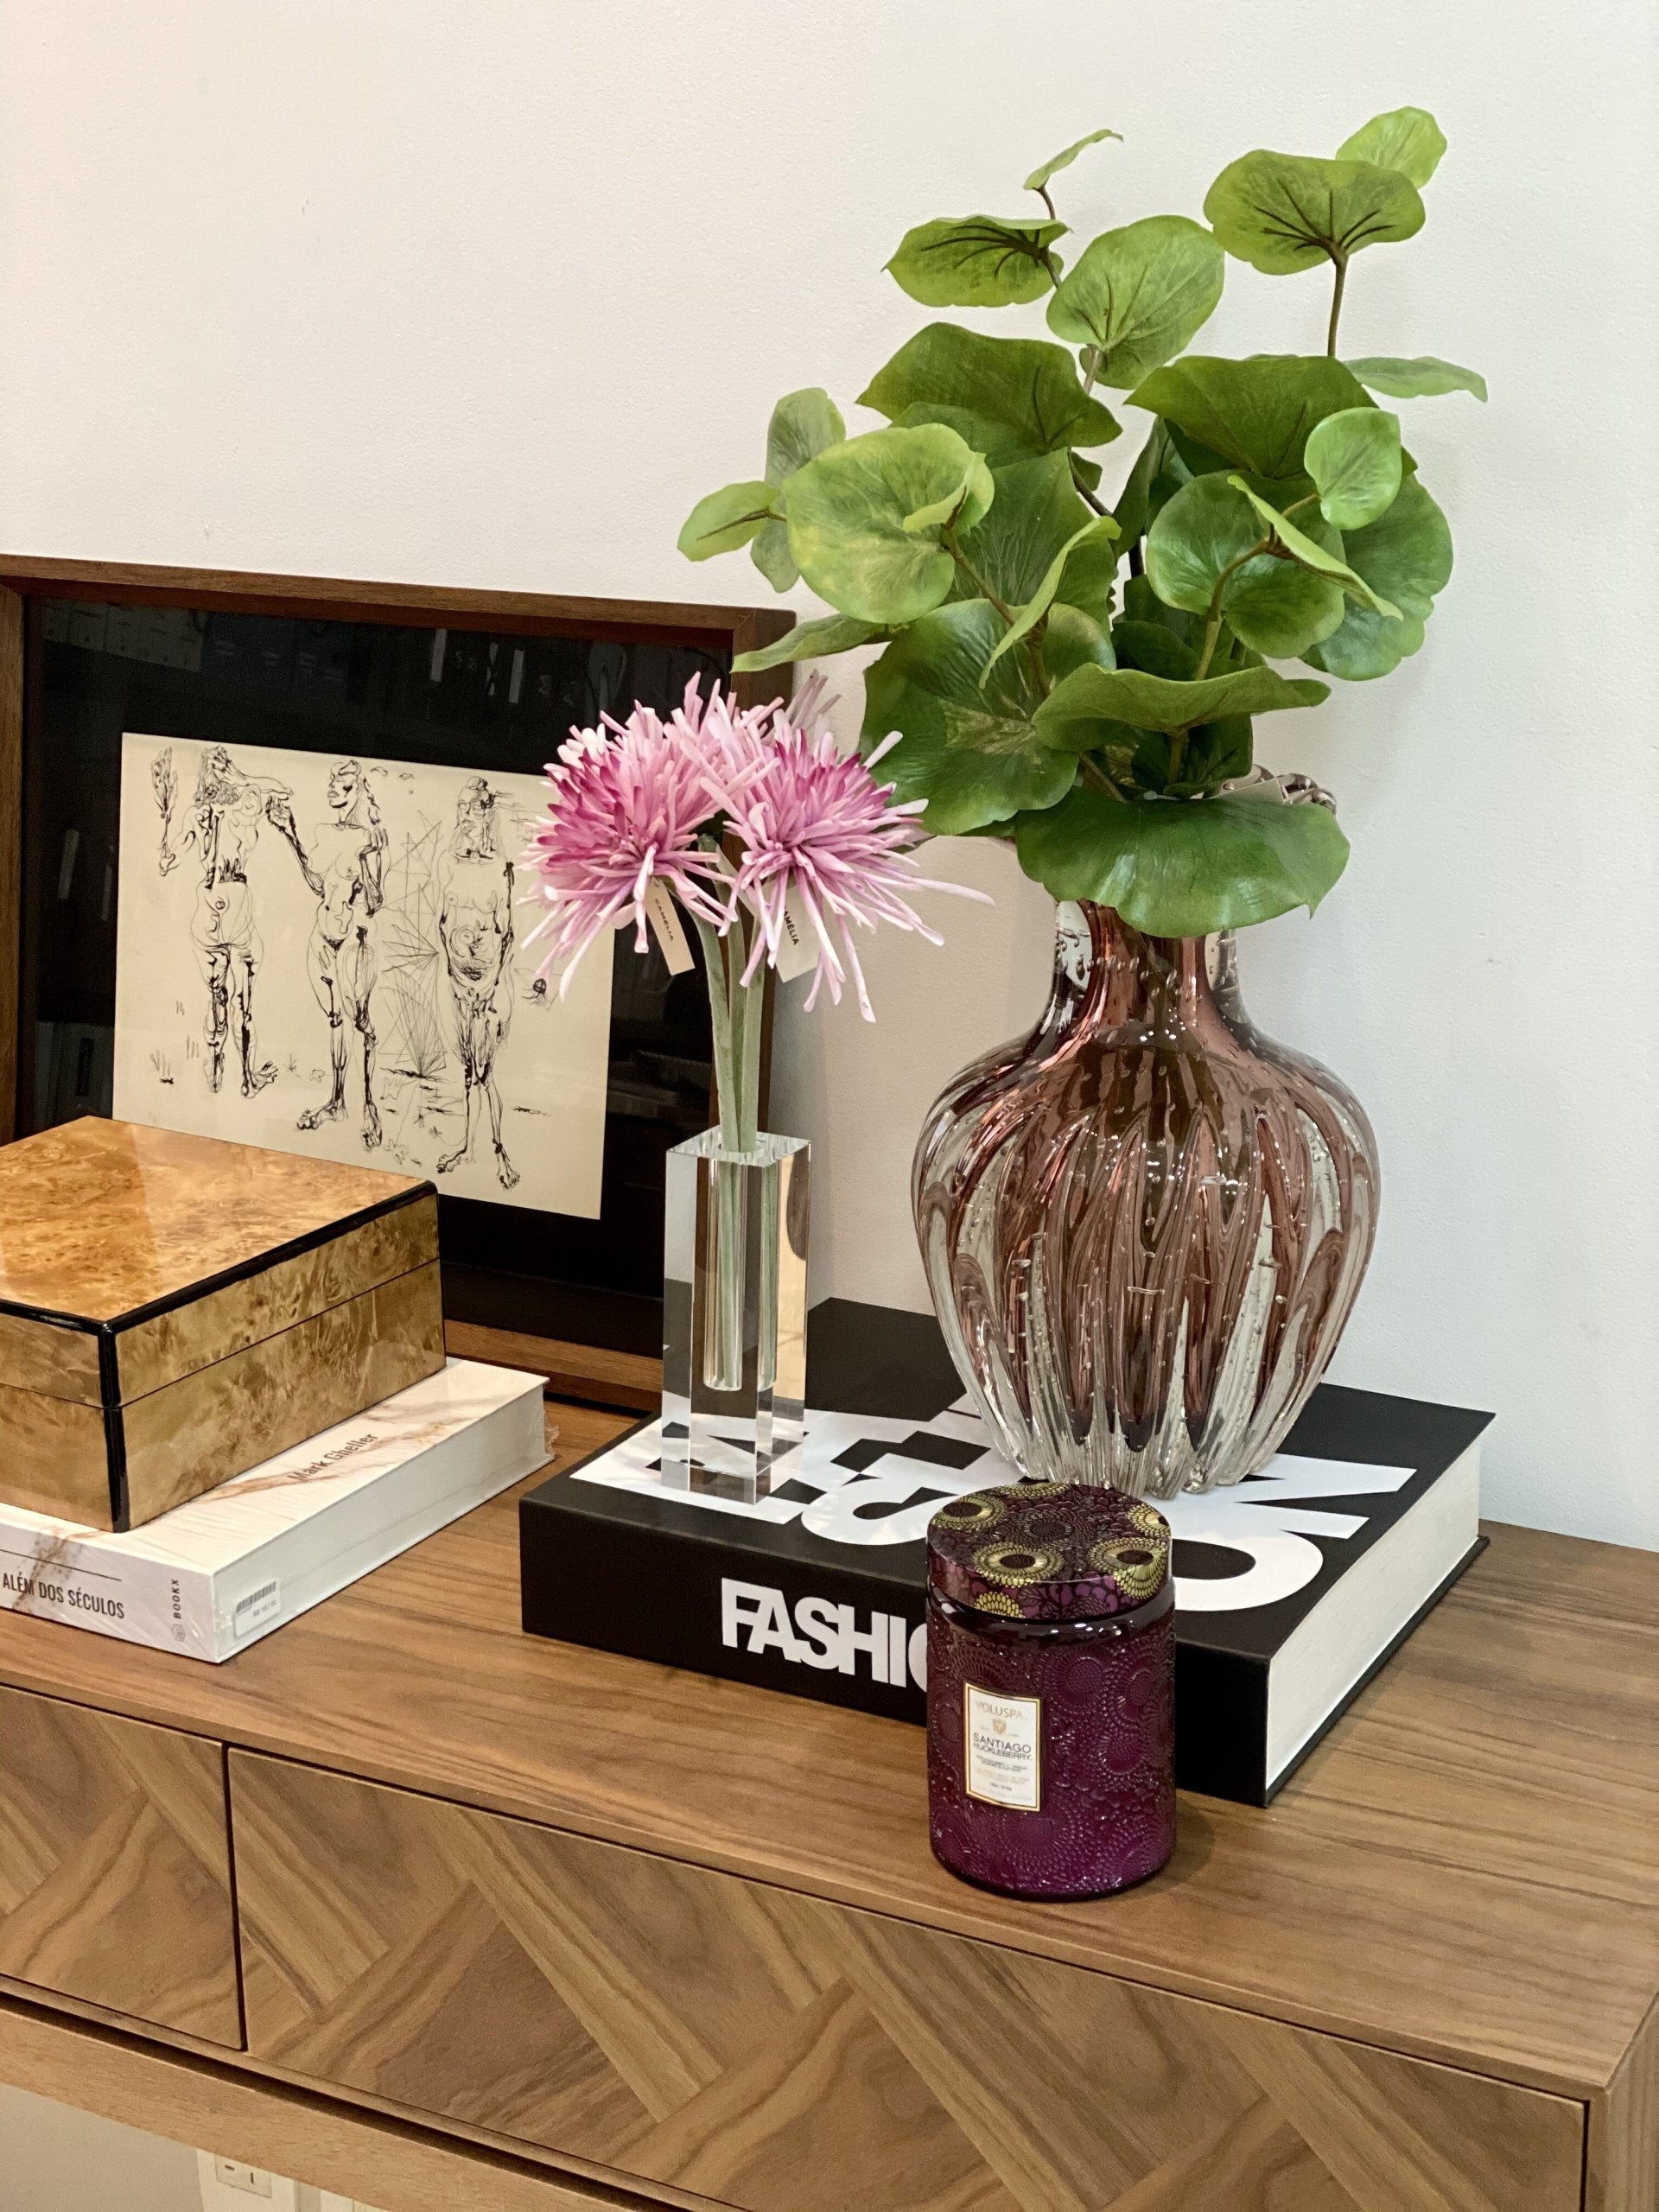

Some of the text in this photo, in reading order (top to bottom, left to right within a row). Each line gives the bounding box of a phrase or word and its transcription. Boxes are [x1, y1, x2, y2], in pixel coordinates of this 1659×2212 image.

[783, 905, 800, 945] AMÉLIA
[286, 1433, 379, 1483] Mark Gheller
[3, 1572, 125, 1619] ALÉM DOS SÉCULOS
[975, 1700, 1025, 1720] VOLUSPA
[973, 1732, 1033, 1754] SANTIAGO
